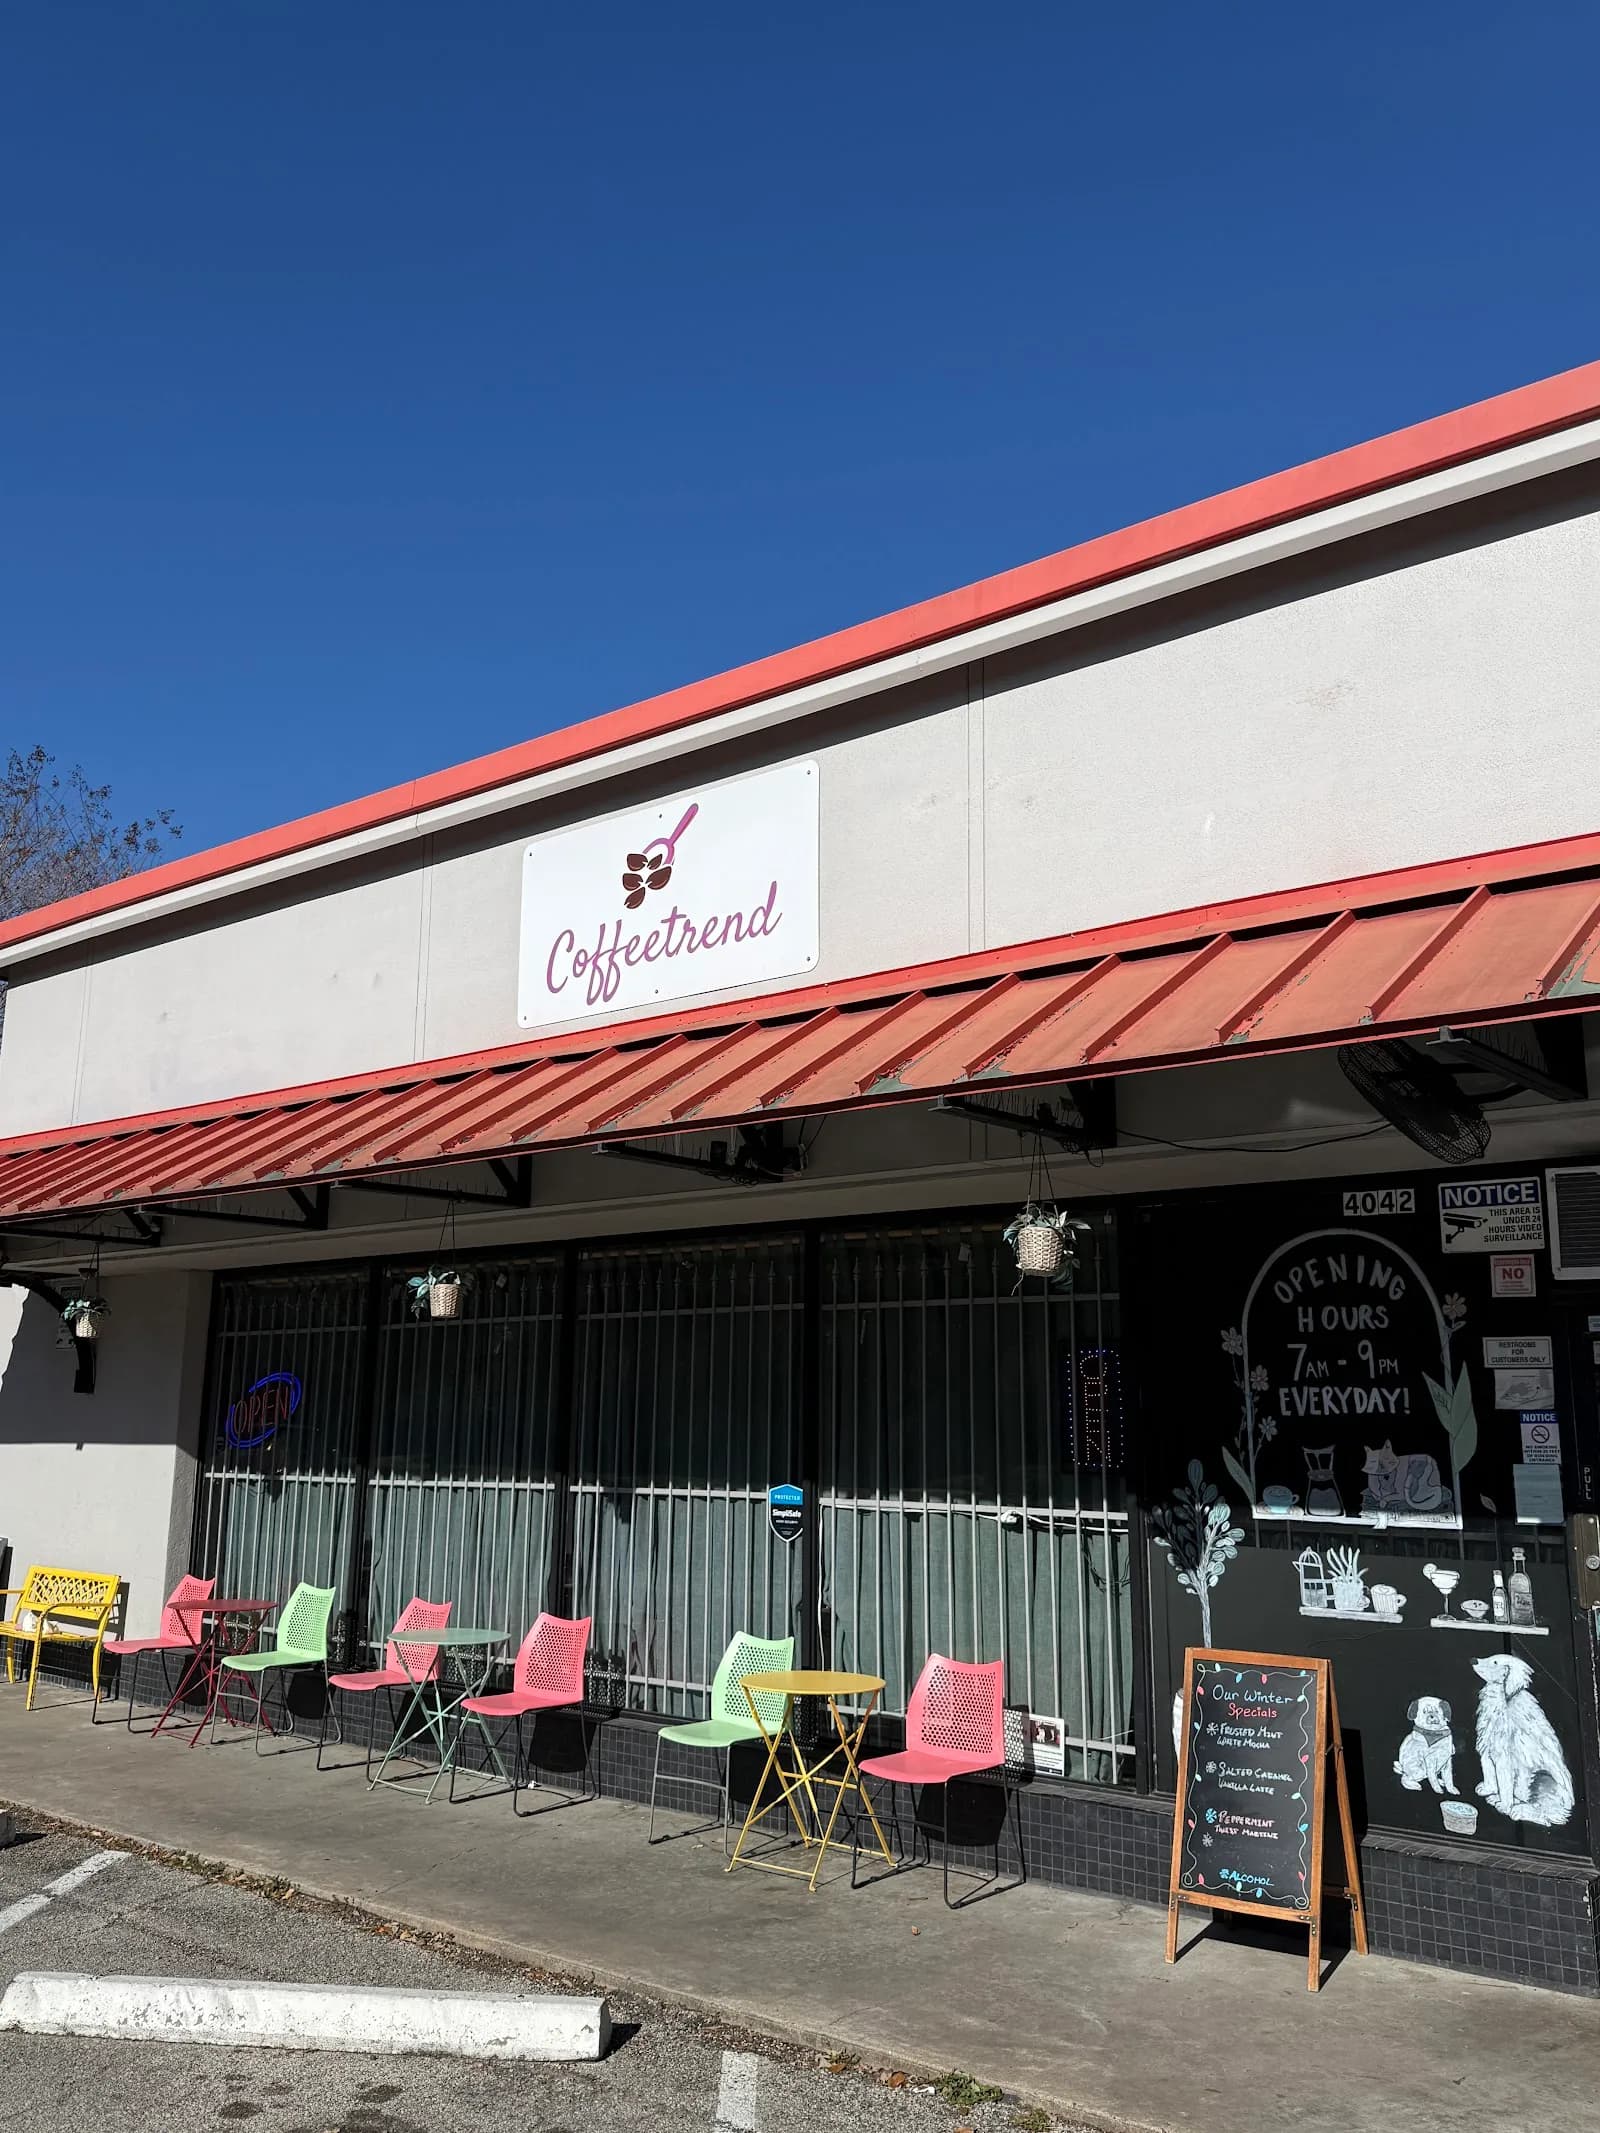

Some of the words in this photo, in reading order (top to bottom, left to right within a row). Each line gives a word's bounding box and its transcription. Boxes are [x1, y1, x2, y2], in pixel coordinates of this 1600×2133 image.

[547, 881, 782, 1005] Coffeetrend
[1344, 1190, 1413, 1215] 4042
[1444, 1182, 1536, 1207] NOTICE
[1488, 1208, 1507, 1216] THIS
[1509, 1207, 1530, 1215] AREA
[1532, 1206, 1541, 1214] IS
[1503, 1216, 1531, 1224] UNDER
[1532, 1215, 1541, 1223] 24
[1483, 1232, 1543, 1242] SURVEILLANCE
[1488, 1225, 1516, 1233] HOURS
[1518, 1224, 1542, 1232] VIDEO
[1274, 1254, 1406, 1303] OPENING
[1502, 1267, 1524, 1280] NO
[1298, 1305, 1389, 1333] HOURS
[234, 1386, 289, 1433] OPEN
[1080, 1354, 1112, 1461] OPEN
[1279, 1386, 1411, 1416] EVERYDAY!
[1522, 1413, 1557, 1422] NOTICE
[1583, 1467, 1592, 1500] PULL
[1212, 1684, 1240, 1701] Our
[1244, 1689, 1295, 1704] Winter
[1228, 1702, 1277, 1720] Specials
[1242, 1738, 1270, 1749] MOCHA
[1218, 1761, 1252, 1777] SALTED
[1254, 1768, 1293, 1782] CARAMEL
[1218, 1810, 1276, 1828] PEPPERMINT
[1228, 1870, 1275, 1886] ALCOHOL
